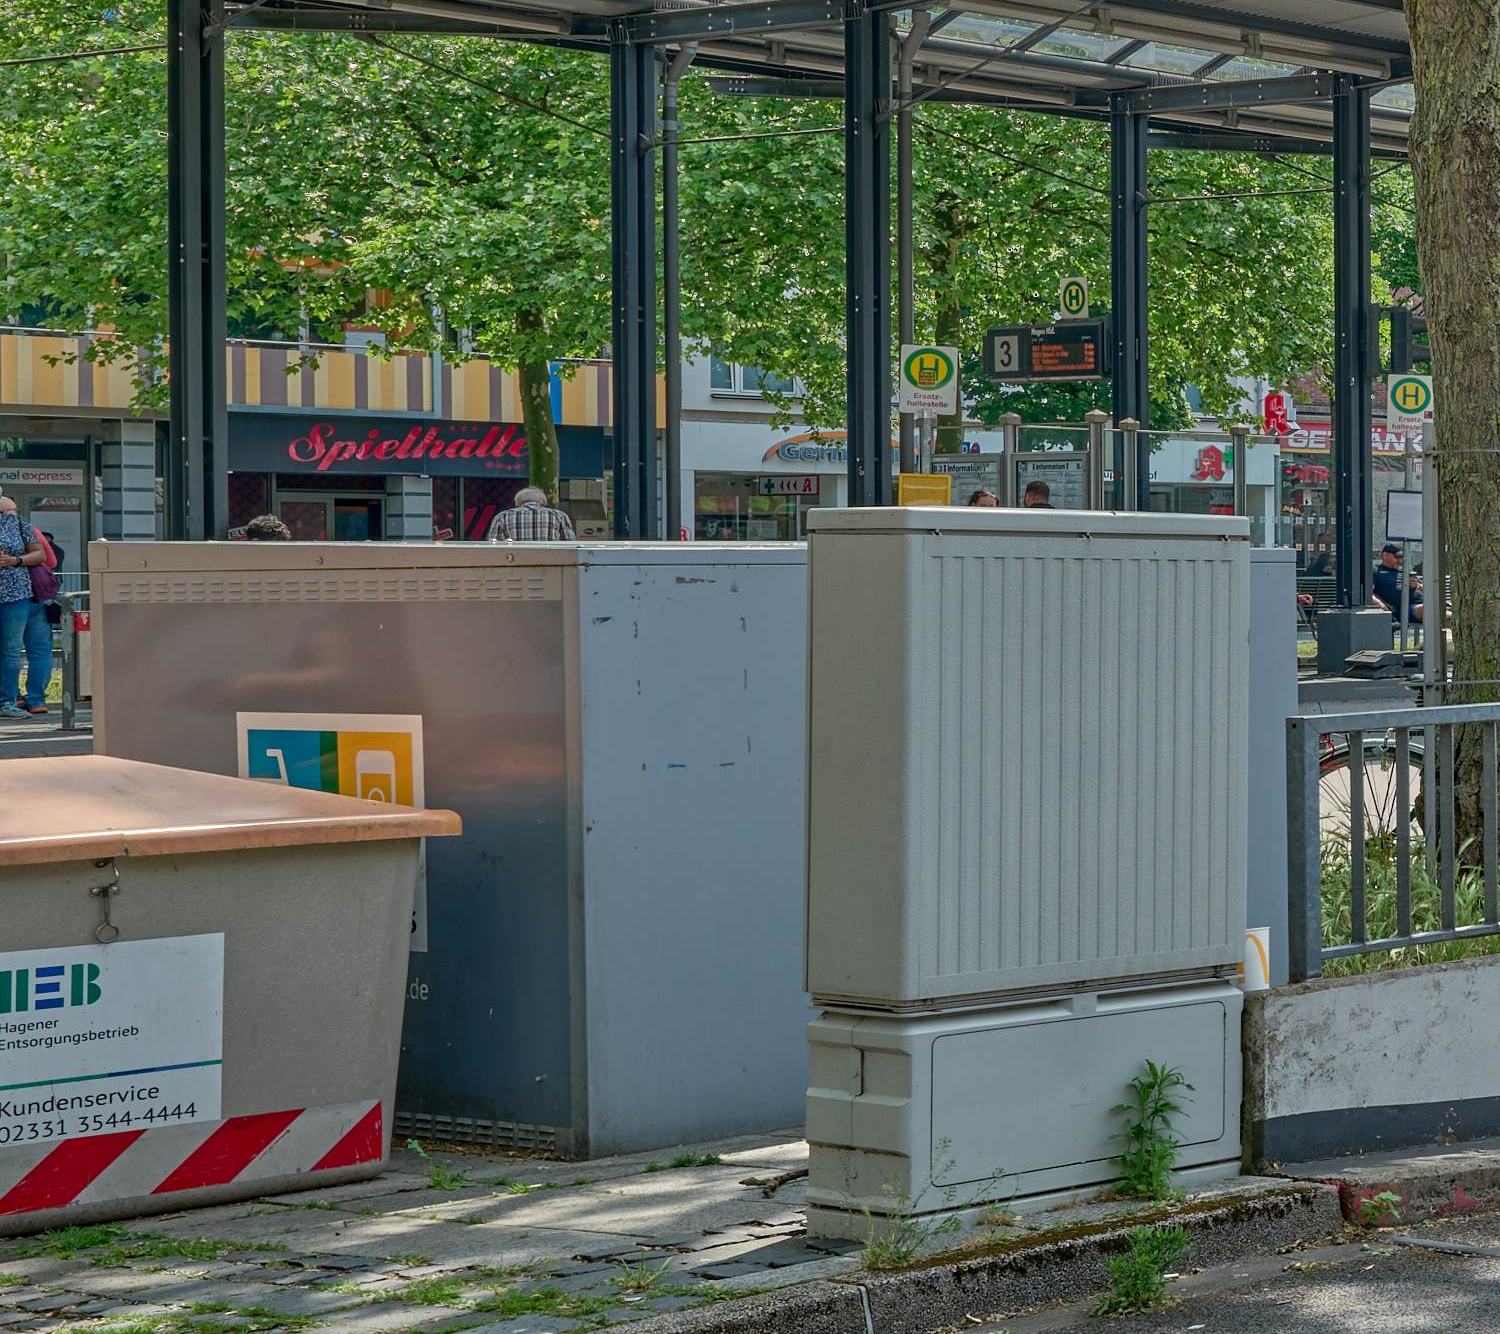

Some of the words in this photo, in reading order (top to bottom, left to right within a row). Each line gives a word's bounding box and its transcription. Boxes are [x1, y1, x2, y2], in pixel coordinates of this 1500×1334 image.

[1068, 287, 1080, 308] H
[1000, 340, 1013, 367] 3
[1402, 385, 1419, 406] H
[288, 422, 529, 471] Spielhalle
[22, 471, 73, 482] express
[0, 1019, 60, 1035] Hagener
[0, 1025, 140, 1051] Entsorgungsbetrieb
[0, 1085, 160, 1117] Kundenservice
[0, 1119, 67, 1143] 02331
[78, 1102, 197, 1133] 3544-4444
